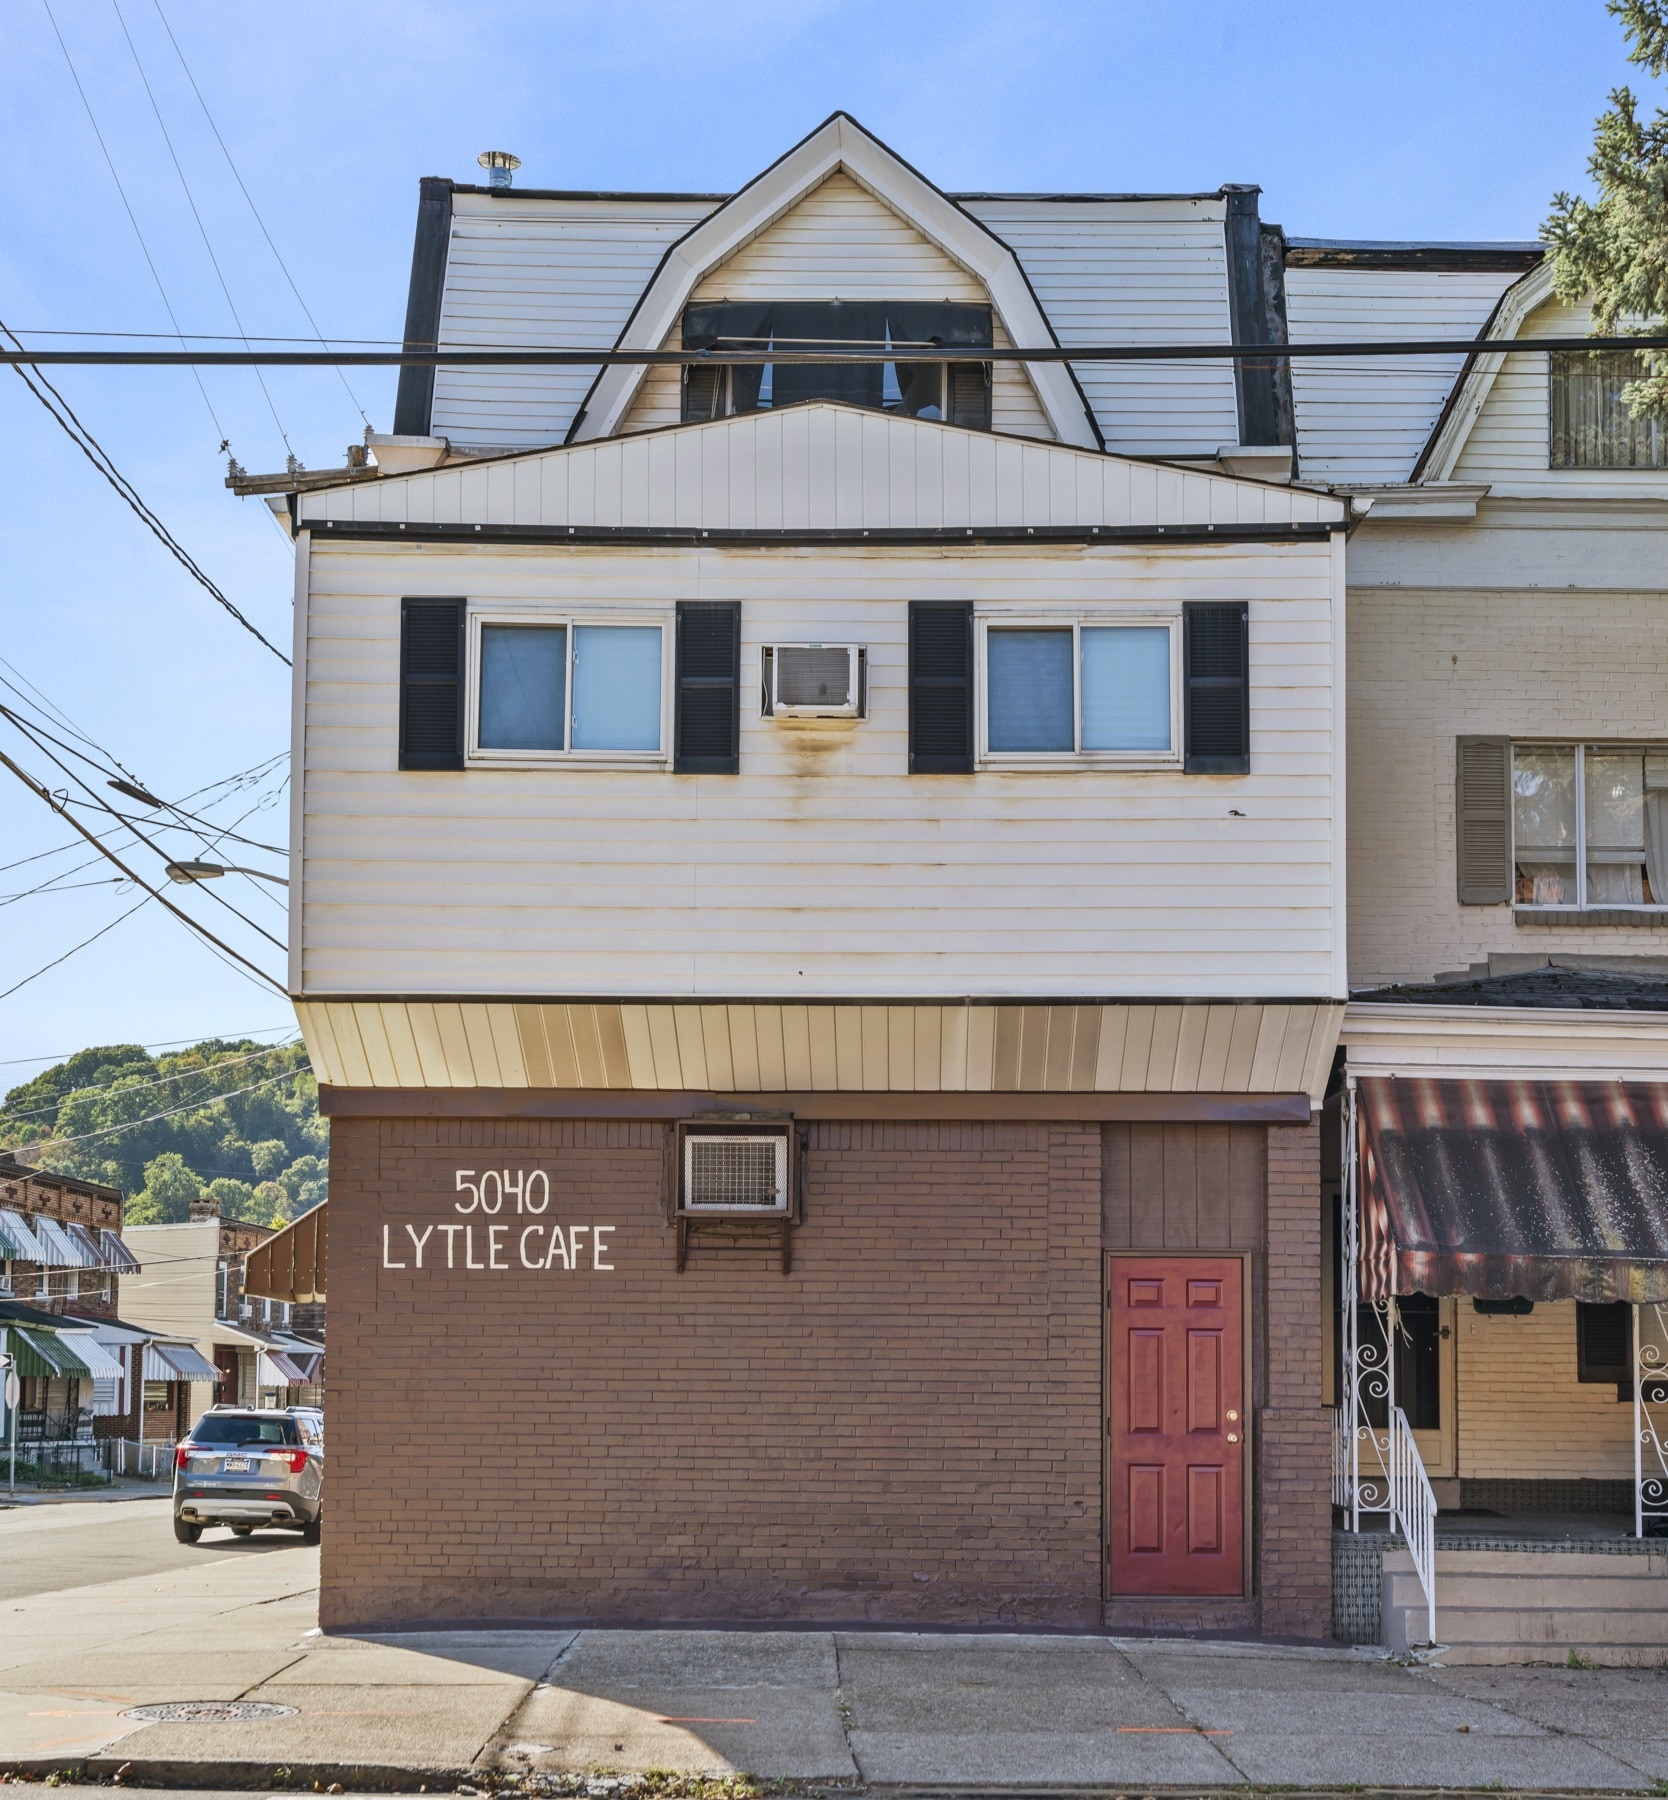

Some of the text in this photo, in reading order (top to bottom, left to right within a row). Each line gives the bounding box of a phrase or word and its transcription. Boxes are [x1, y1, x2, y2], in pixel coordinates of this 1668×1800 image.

[454, 1169, 550, 1214] 5040
[383, 1224, 616, 1271] LYTLE CAFE
